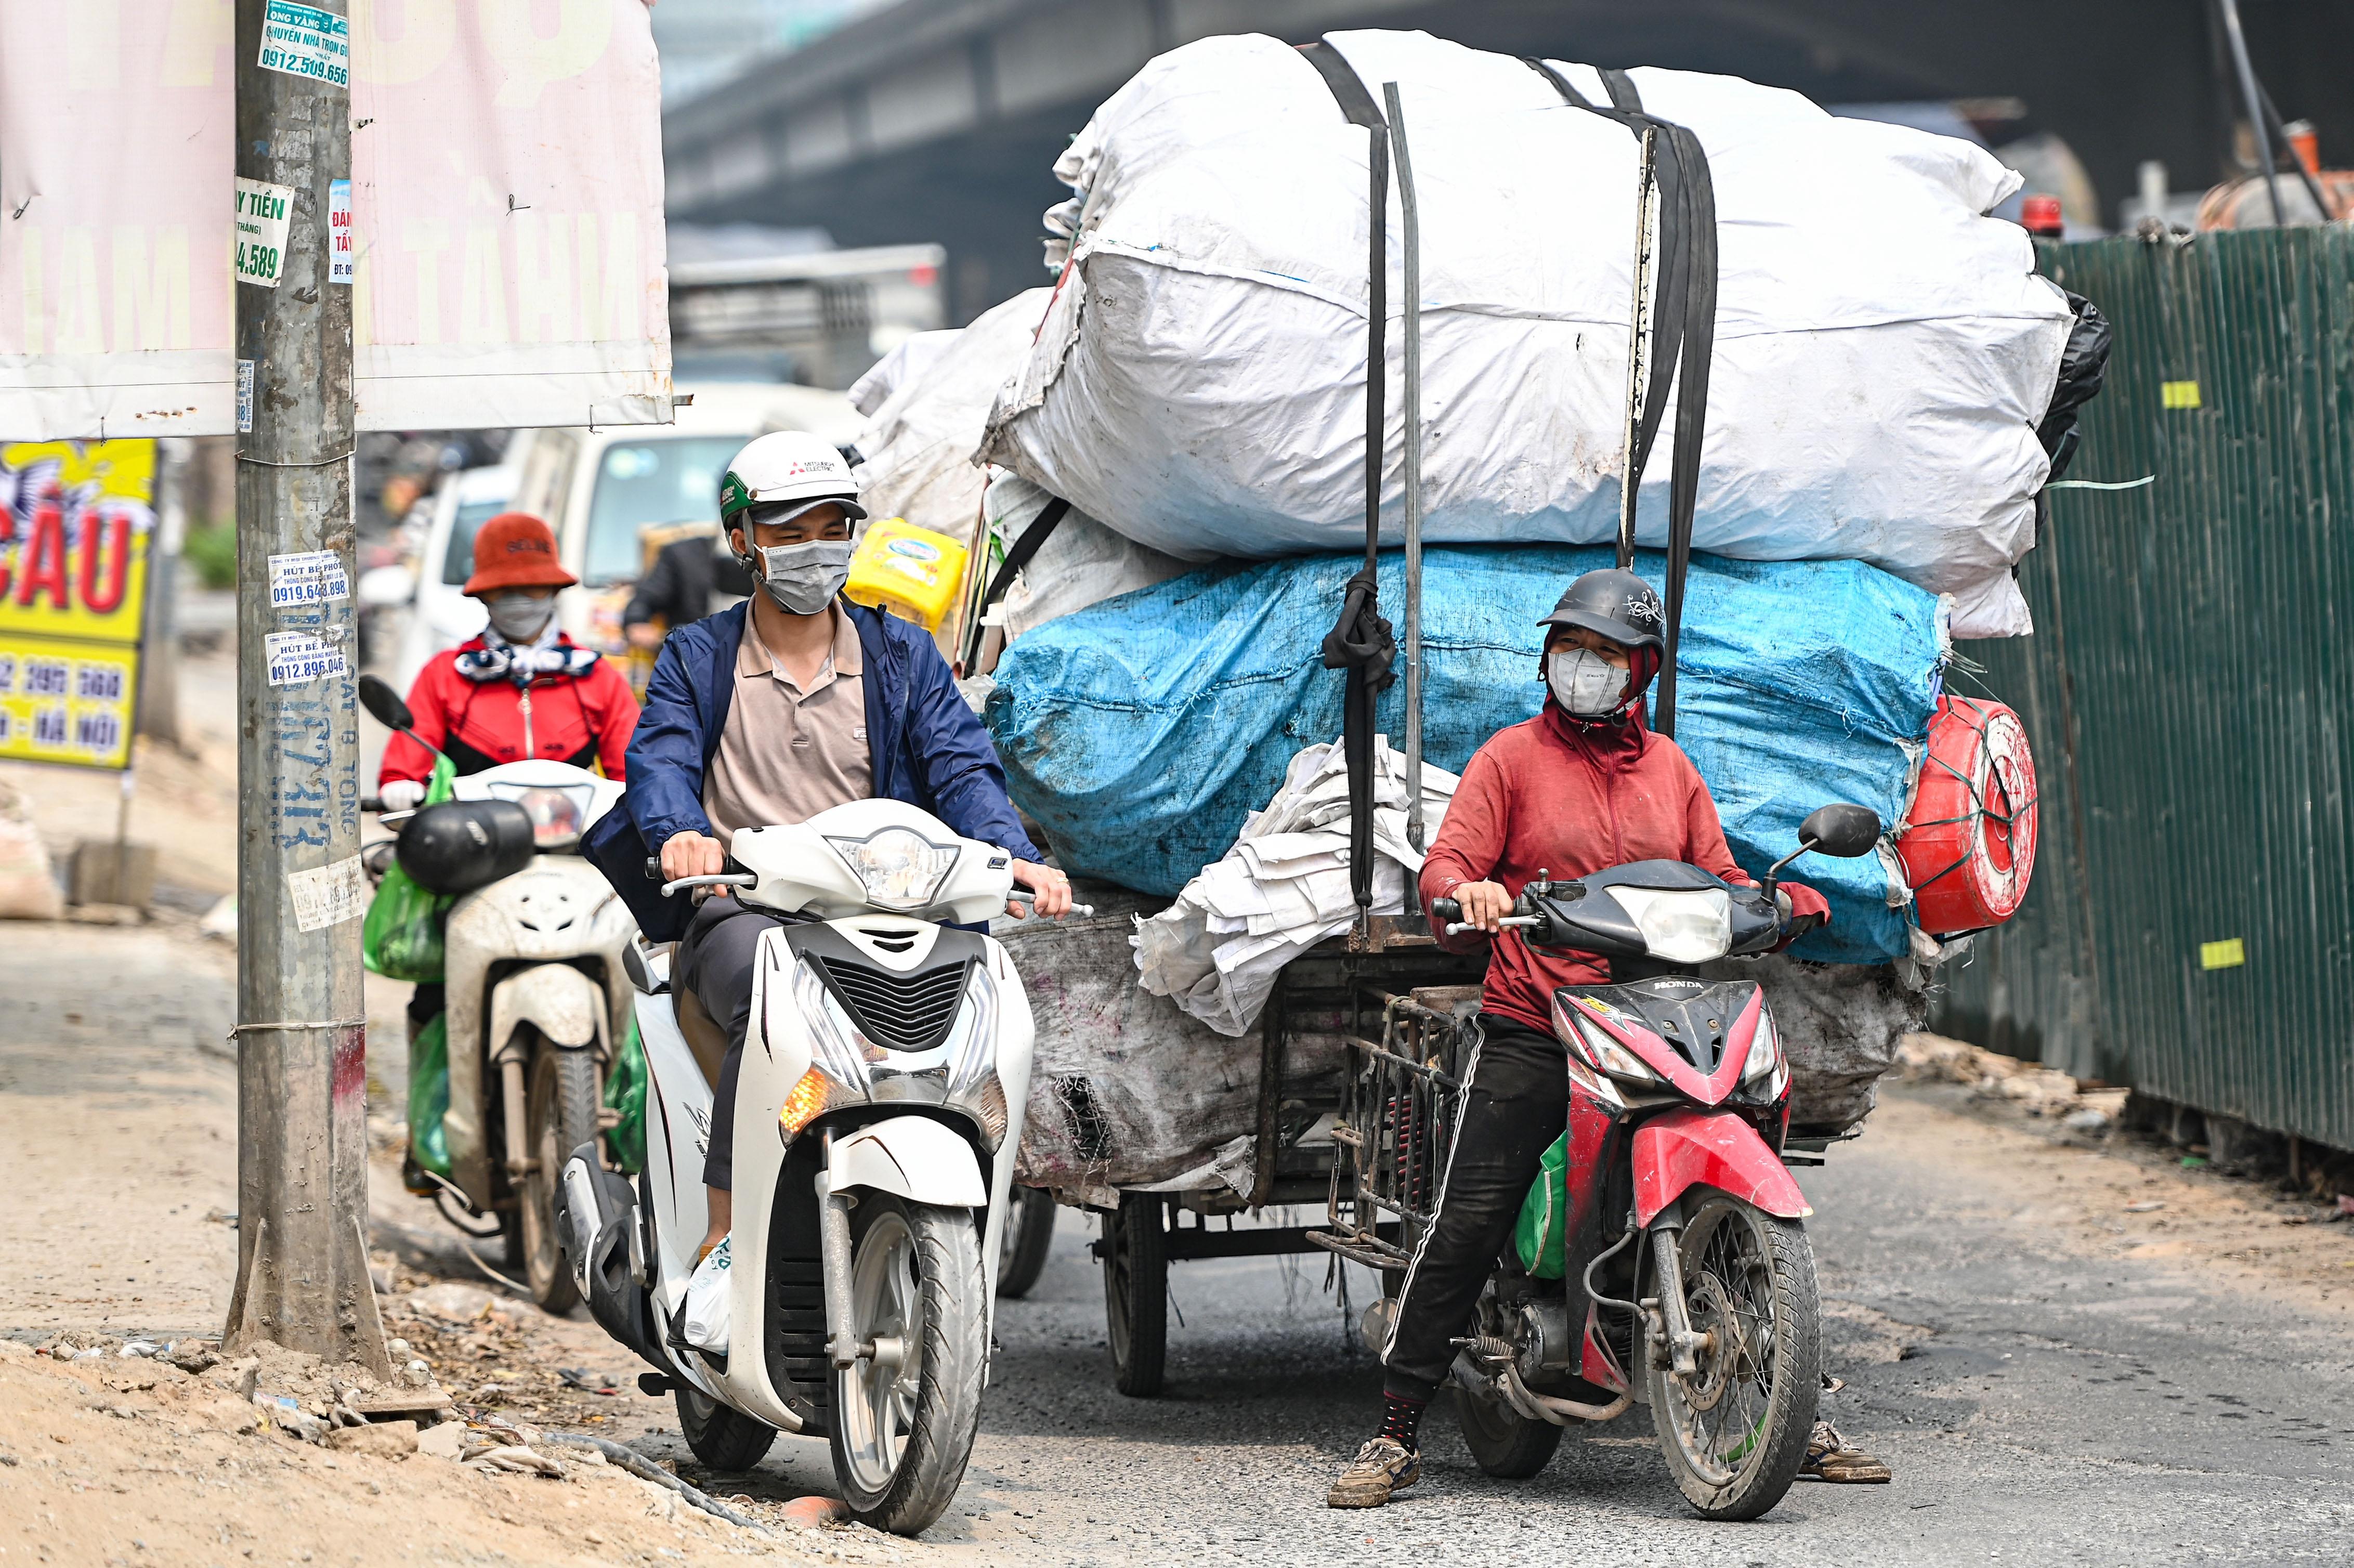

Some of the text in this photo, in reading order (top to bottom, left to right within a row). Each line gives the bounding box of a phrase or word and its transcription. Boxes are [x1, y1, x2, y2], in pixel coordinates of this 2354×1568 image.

[270, 11, 320, 29] ONG VÀNG
[303, 32, 320, 48] NHÀ
[263, 49, 347, 85] 0912.509.656
[250, 190, 285, 220] TIỀN
[334, 264, 344, 275] ĐT:
[284, 566, 305, 576] HÚT
[273, 580, 346, 602] 0919.648.898
[281, 644, 302, 654] HÚT
[306, 639, 319, 651] BỂ
[272, 657, 344, 681] 0912.896.046
[1654, 981, 1705, 990] HONDA
